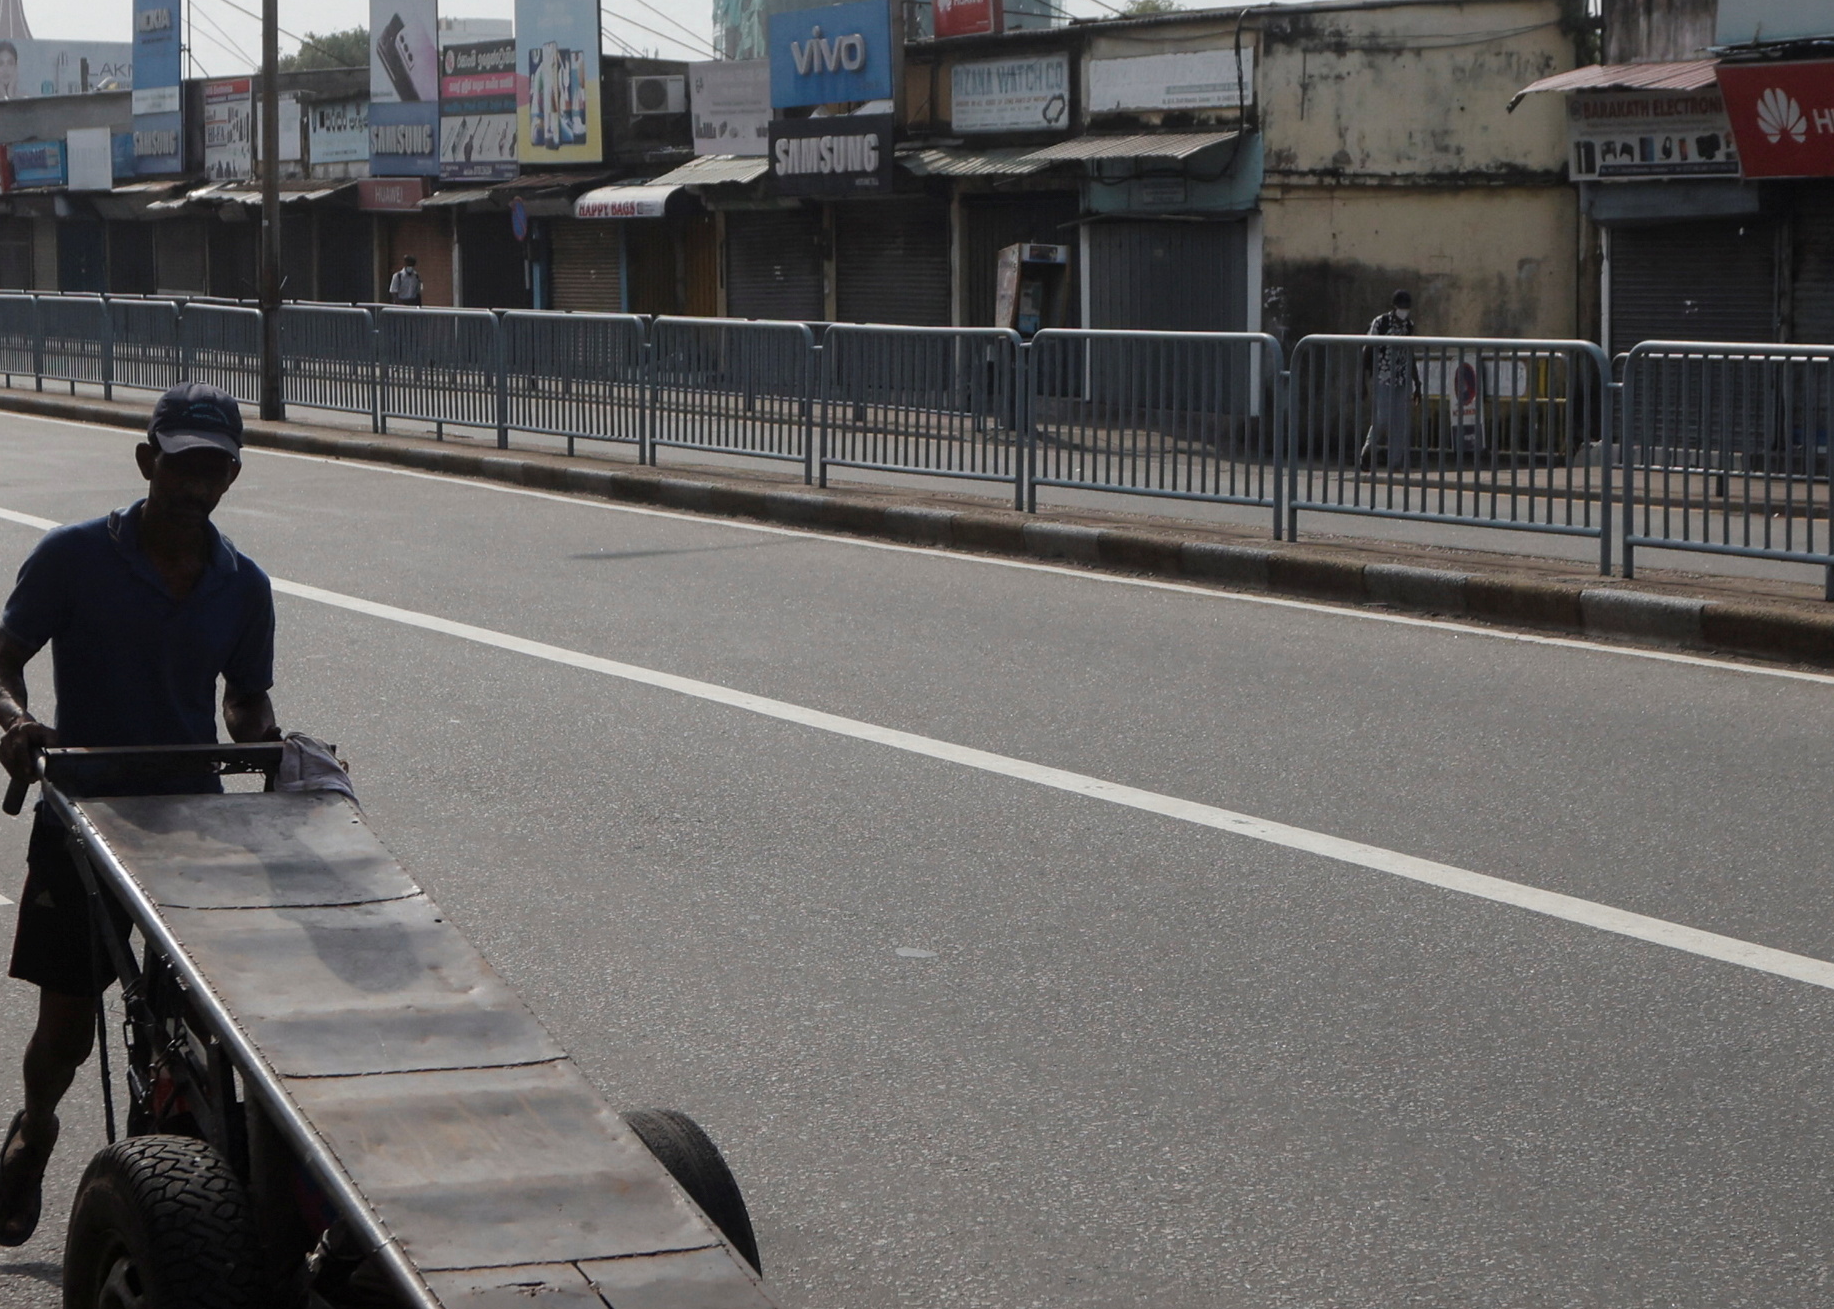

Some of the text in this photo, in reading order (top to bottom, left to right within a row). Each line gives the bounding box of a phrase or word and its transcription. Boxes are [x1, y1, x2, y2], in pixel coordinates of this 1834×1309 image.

[997, 63, 1043, 94] WATCH
[1584, 99, 1649, 119] BARAKATH
[134, 130, 177, 157] SAMSUNG
[371, 124, 433, 155] SAMSUNG
[775, 133, 879, 176] SAMSUNG
[374, 186, 403, 203] HUAWEI
[578, 199, 636, 217] HAPPY BAGS
